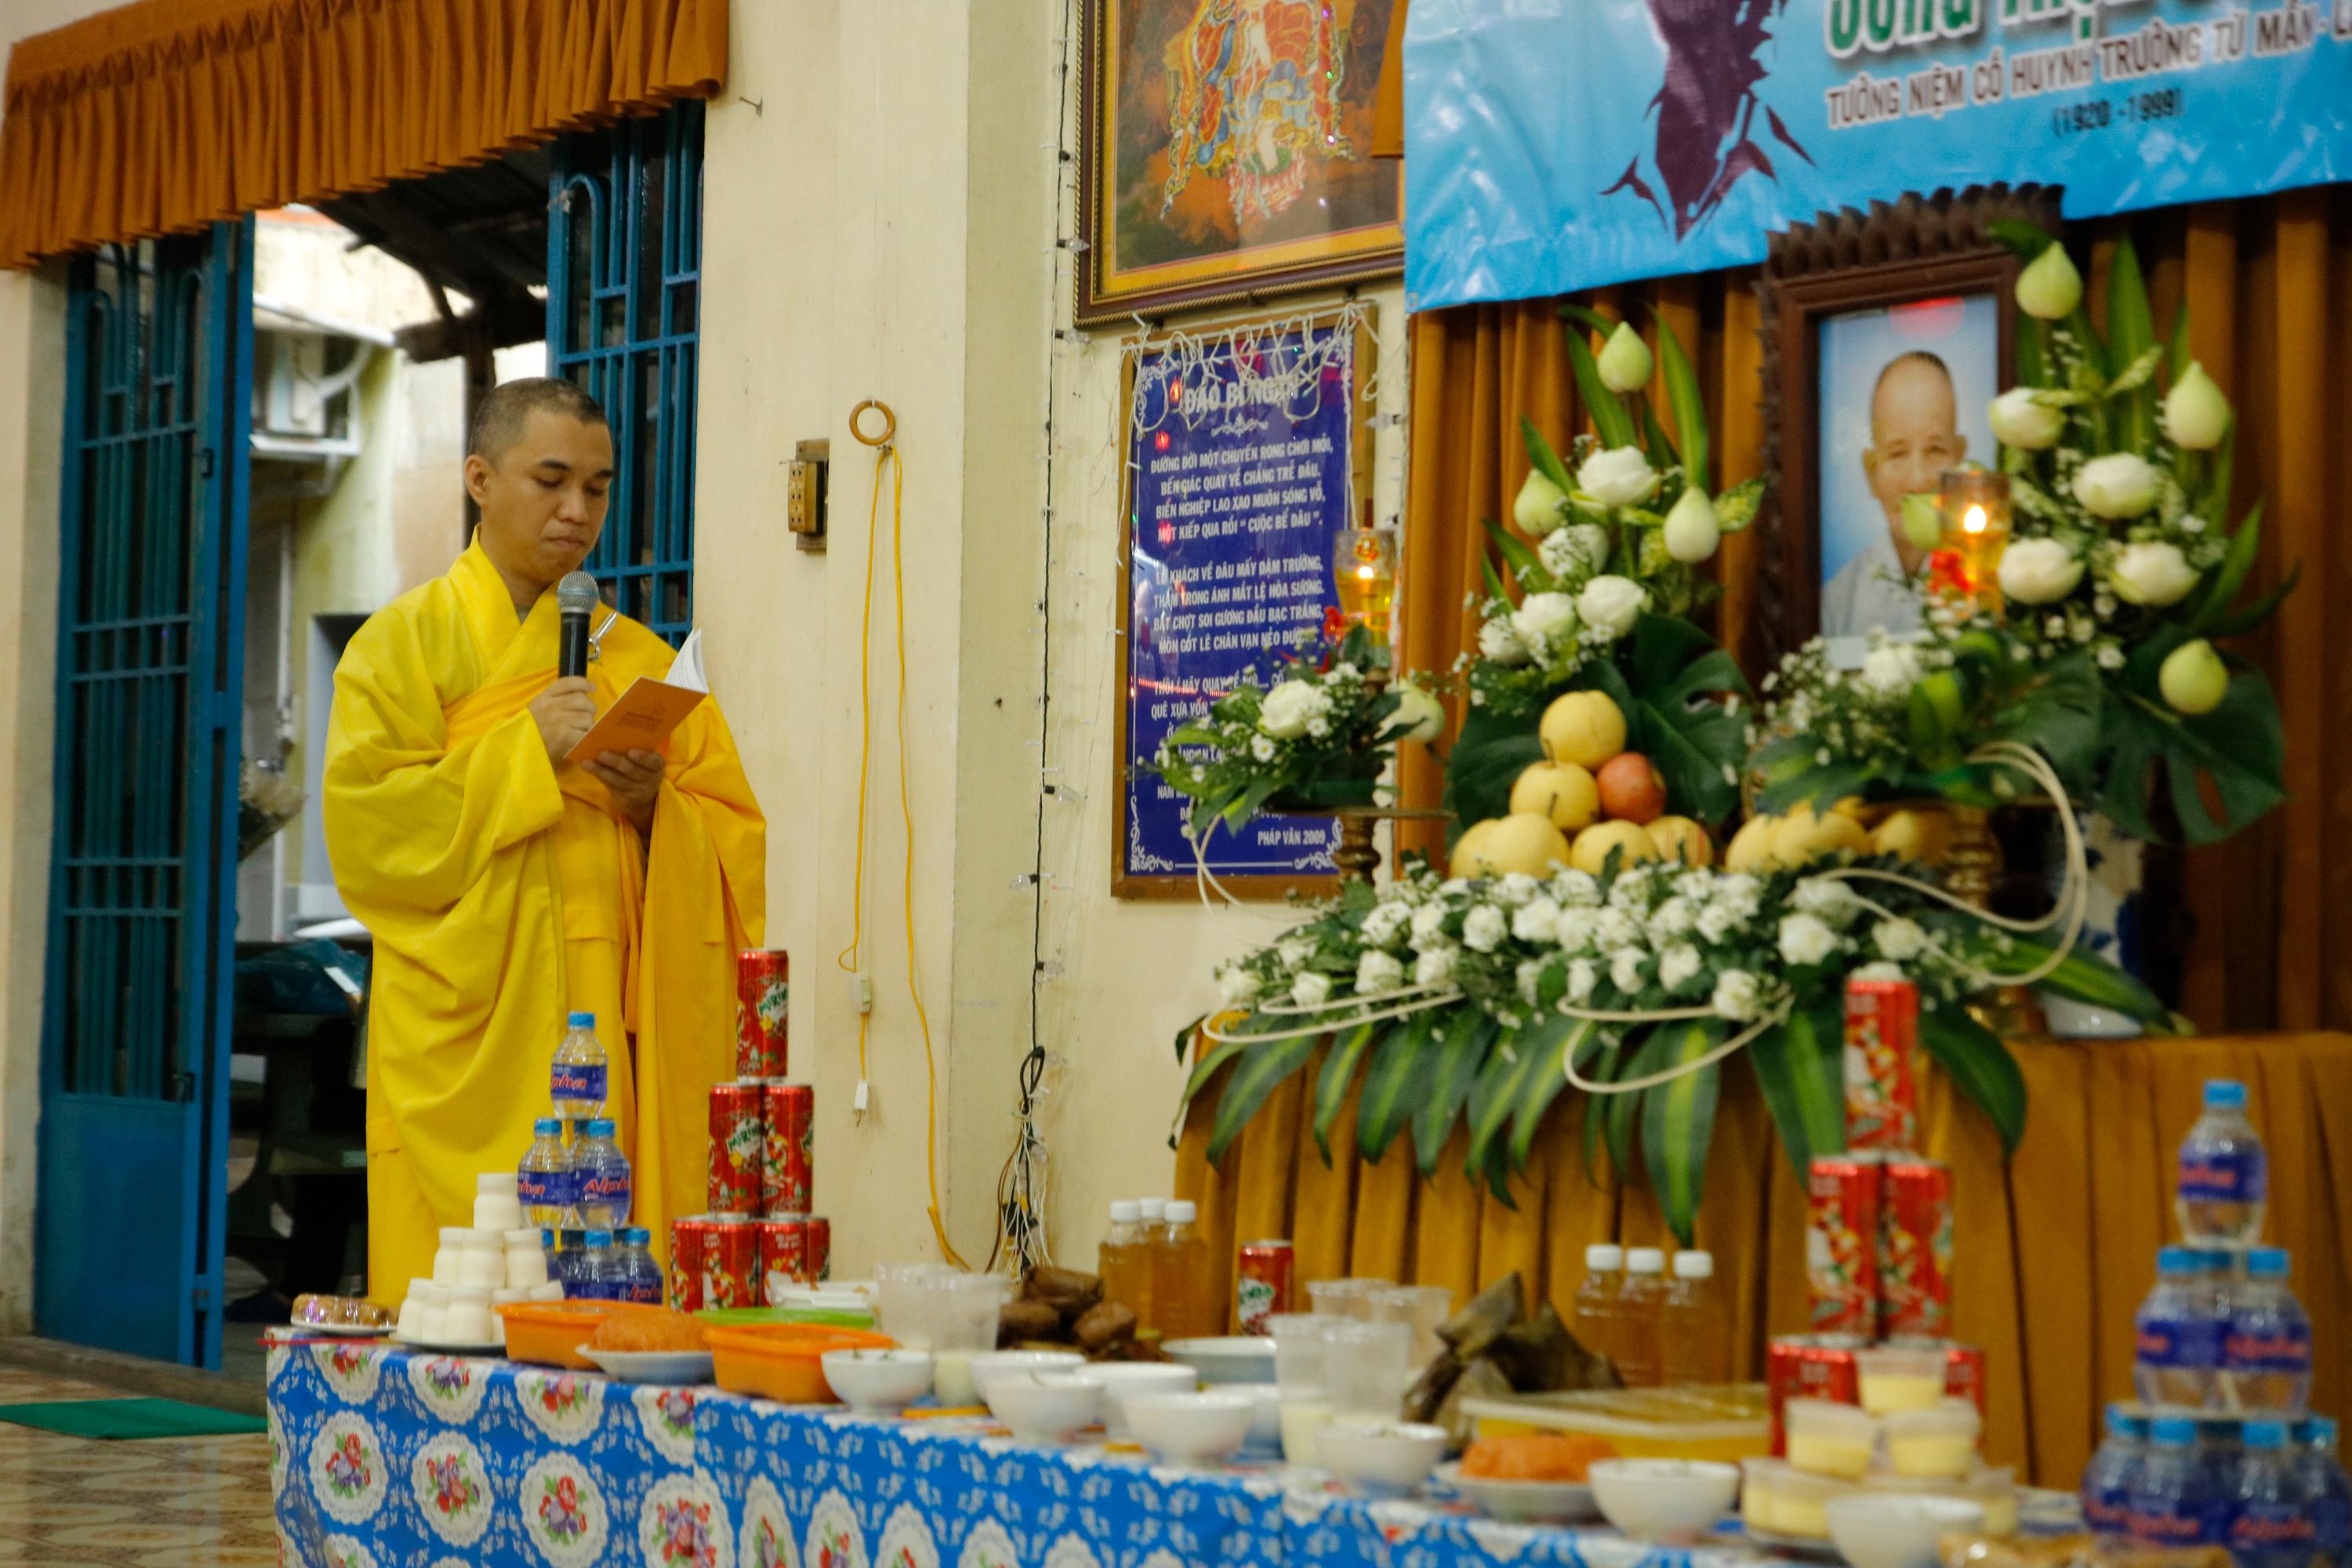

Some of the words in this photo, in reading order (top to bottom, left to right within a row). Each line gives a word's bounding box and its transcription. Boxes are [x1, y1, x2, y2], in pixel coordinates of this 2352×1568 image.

[1907, 63, 1965, 118] NIỆM
[1151, 455, 1180, 474] ĐƯỜNG
[1200, 448, 1218, 469] MỘT
[1221, 441, 1258, 464] CHUYẾN
[1260, 443, 1286, 460] RONG
[1203, 474, 1226, 492] QUAY
[1178, 496, 1211, 517] NGHIỆP
[1213, 497, 1231, 513] LAO
[1232, 494, 1250, 510] XAO
[1253, 488, 1280, 508] MUÔN
[1282, 486, 1308, 505] SÓNG
[1179, 519, 1200, 540] KIẾP
[1202, 522, 1220, 539] QUA
[1248, 514, 1272, 533] CUỘC
[1169, 564, 1200, 584] KHÁCH
[1211, 585, 1230, 604] ÁNH
[1254, 581, 1266, 602] LỆ
[1198, 613, 1213, 628] SOI
[1214, 608, 1244, 626] GƯƠNG
[1268, 607, 1287, 625] BẠC
[1200, 633, 1211, 652] LÊ
[1214, 631, 1238, 650] CHÂN
[1240, 633, 1259, 651] VẠN
[1151, 700, 1168, 720] QUÊ
[1171, 700, 1188, 719] XƯA
[1157, 786, 1174, 800] NAM
[1258, 827, 1282, 846] PHÁP
